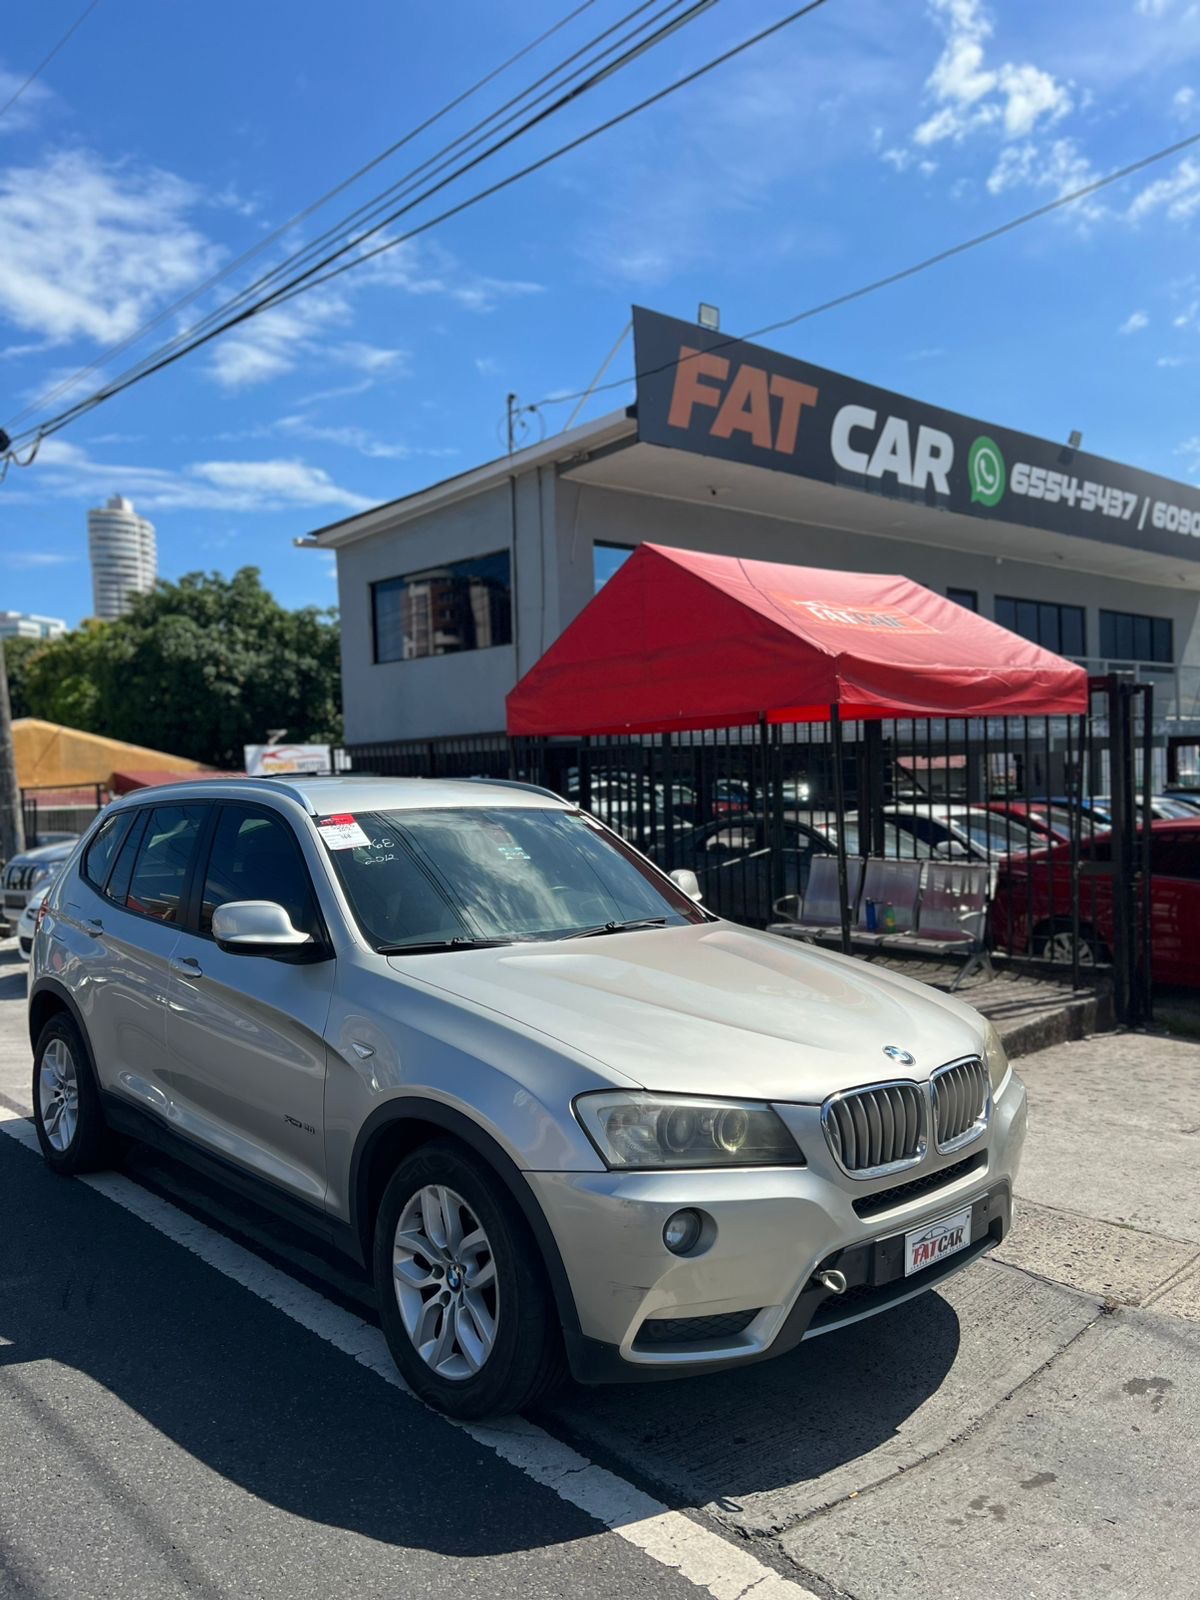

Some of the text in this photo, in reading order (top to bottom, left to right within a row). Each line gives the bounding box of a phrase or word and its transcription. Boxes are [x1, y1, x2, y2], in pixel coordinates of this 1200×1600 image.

[667, 345, 955, 495] FAT CAR
[1010, 462, 1138, 520] 6554-5437
[364, 853, 400, 865] 2012
